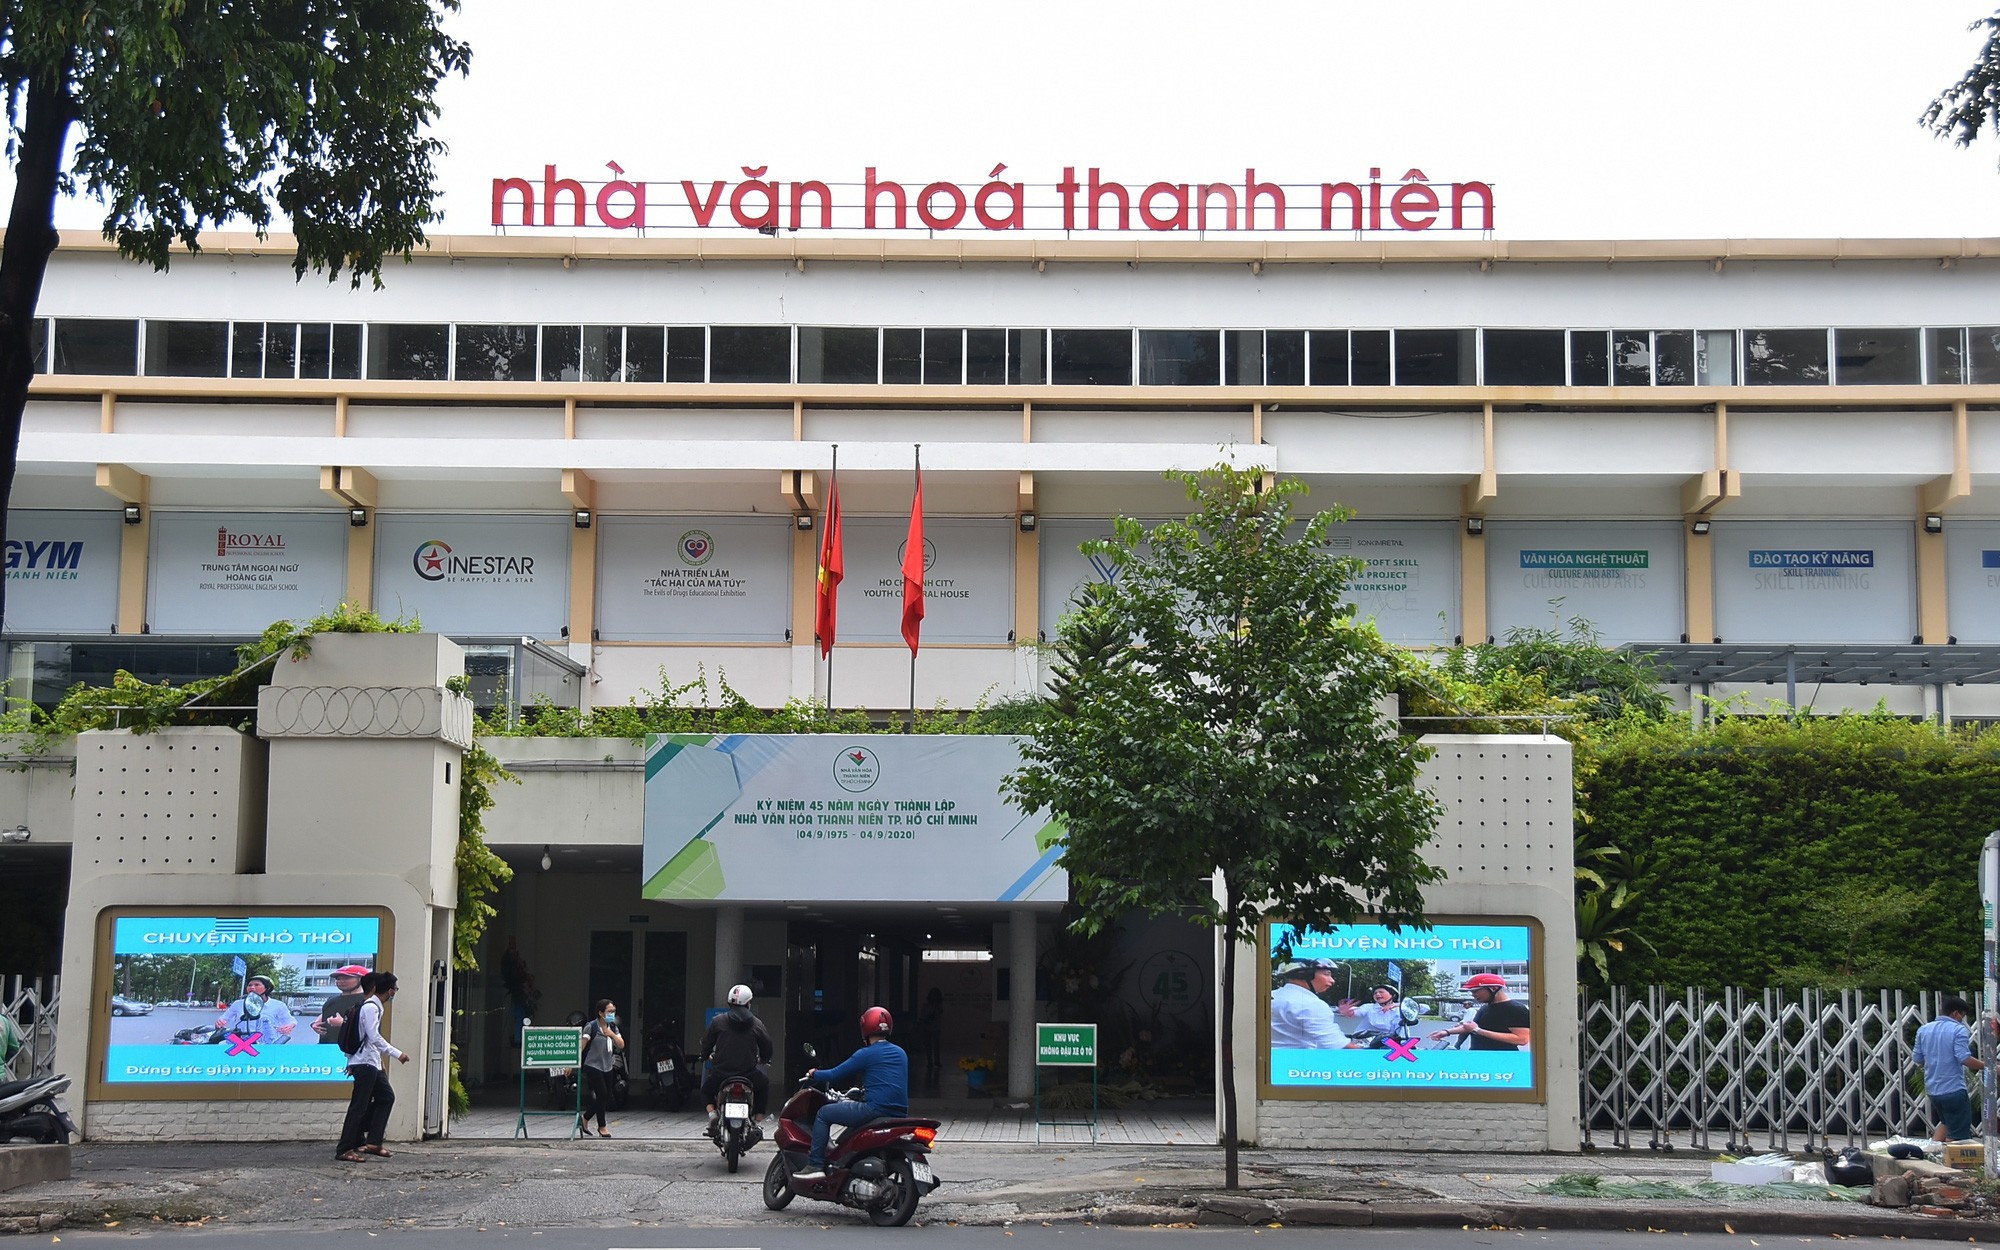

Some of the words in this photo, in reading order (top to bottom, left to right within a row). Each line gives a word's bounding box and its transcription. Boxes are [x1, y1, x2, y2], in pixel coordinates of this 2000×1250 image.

[492, 160, 646, 229] nhà
[681, 165, 832, 229] văn
[865, 163, 1023, 231] hoá
[1056, 166, 1286, 231] thanh
[1321, 168, 1494, 231] niên
[227, 534, 286, 546] ROYAL
[413, 540, 534, 581] CINESTAR
[1523, 552, 1546, 564] VĂN
[1549, 552, 1574, 564] HÓA
[1576, 552, 1608, 566] NGHỆ
[1609, 552, 1646, 566] THUẬT
[1754, 552, 1782, 564] ĐÀO
[1784, 554, 1809, 567] TẠO
[1812, 552, 1828, 564] KỸ
[1832, 552, 1870, 564] NĂNG
[202, 564, 230, 572] TRUNG
[232, 562, 250, 572] TÂM
[251, 564, 278, 574] NGOẠI
[280, 564, 300, 572] NGỮ
[660, 568, 680, 578] NHÀ
[682, 568, 708, 578] TRIỂN
[1548, 569, 1582, 578] CULTURE
[1583, 569, 1600, 578] AND
[1601, 569, 1620, 578] ARTS
[1783, 568, 1803, 577] SKILL
[1805, 568, 1840, 577] TRAINING
[5, 571, 40, 579] HANH
[226, 573, 257, 582] HOÀNG
[216, 582, 254, 590] PROFESSIONAL
[670, 580, 685, 588] HẠI
[687, 578, 706, 588] CỦA
[777, 798, 805, 813] NIỆM
[809, 801, 824, 811] 45
[828, 799, 854, 811] NĂM
[858, 799, 889, 811] NGÀY
[894, 799, 931, 811] THÀNH
[935, 799, 956, 813] LẬP
[734, 812, 757, 824] NHÀ
[762, 812, 785, 824] VĂN
[789, 813, 813, 825] HÓA
[817, 815, 854, 825] THANH
[858, 813, 883, 825] NIÊN
[888, 815, 902, 825] TP.
[926, 812, 945, 825] CHÍ
[948, 815, 977, 825] MINH
[144, 930, 237, 946] CHUYỆN
[244, 929, 294, 944] NHỎ
[300, 930, 351, 944] THÔI
[1299, 936, 1388, 952] CHUYỆN
[1394, 936, 1444, 949] NHỎ
[1451, 936, 1502, 950] THÔI
[1054, 1033, 1066, 1042] KHU
[1068, 1033, 1080, 1043] VỰC
[1040, 1045, 1060, 1055] KHÔNG
[1073, 1047, 1079, 1055] XE
[1080, 1046, 1084, 1055] Ô
[1086, 1046, 1093, 1055] TÔ
[126, 1065, 171, 1075] Đừng
[176, 1064, 203, 1074] tức
[206, 1065, 242, 1076] giận
[246, 1065, 276, 1075] hay
[280, 1064, 332, 1075] hoảng
[1288, 1069, 1332, 1080] Đừng
[1336, 1069, 1362, 1078] tức
[1366, 1070, 1401, 1081] giận
[1406, 1070, 1435, 1080] hay
[1439, 1070, 1490, 1081] hoảng
[1494, 1072, 1514, 1082] sợ
